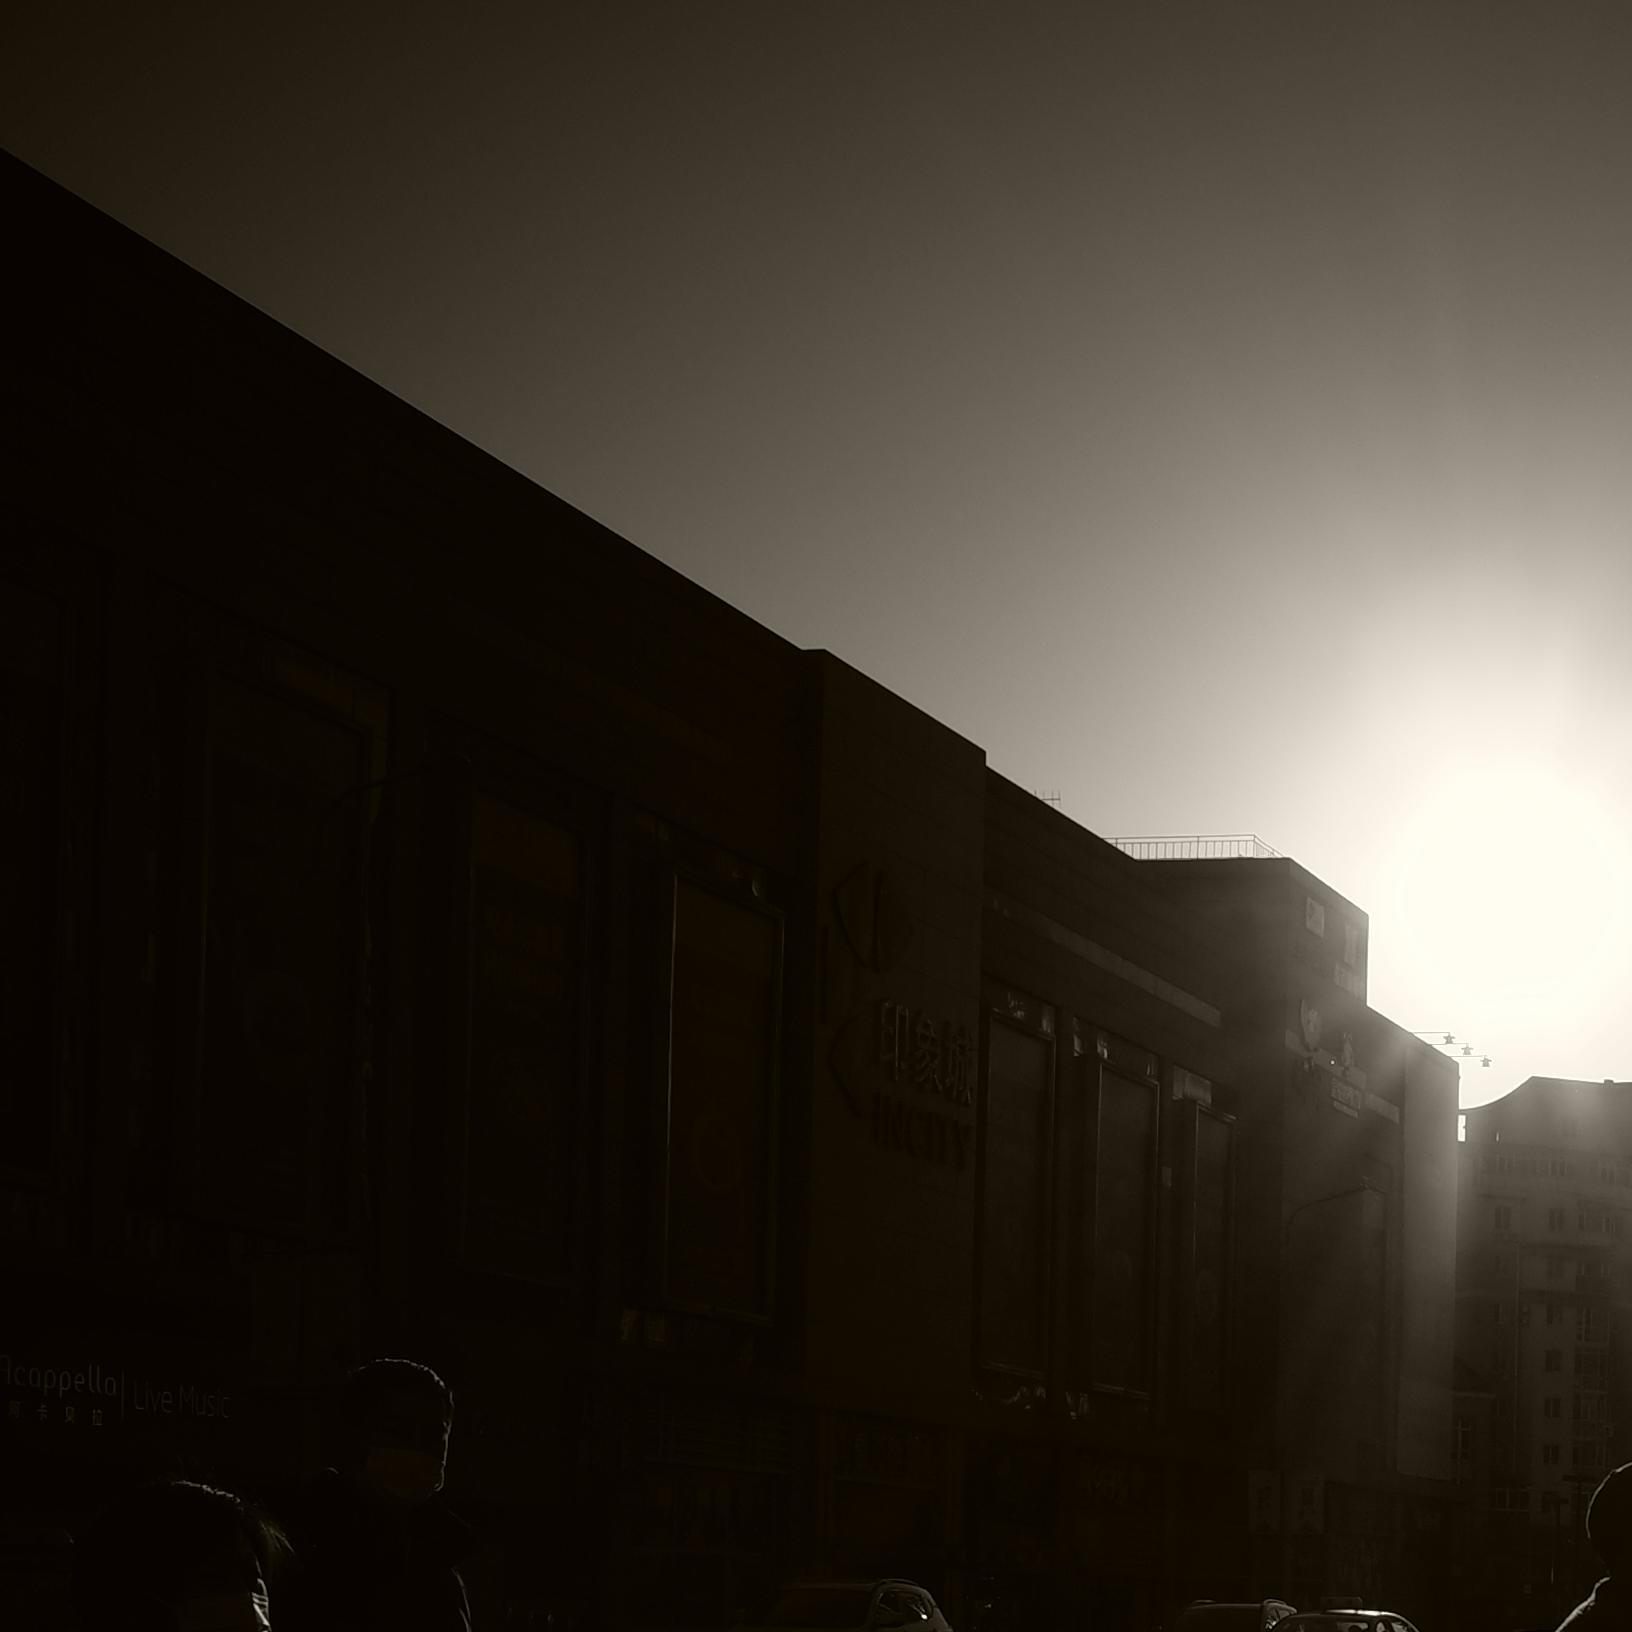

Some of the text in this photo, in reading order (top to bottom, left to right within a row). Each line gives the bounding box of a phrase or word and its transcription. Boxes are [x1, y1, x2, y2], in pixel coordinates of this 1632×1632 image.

[871, 1092, 975, 1171] INCITY
[0, 1354, 232, 1419] Acappella Live Music
